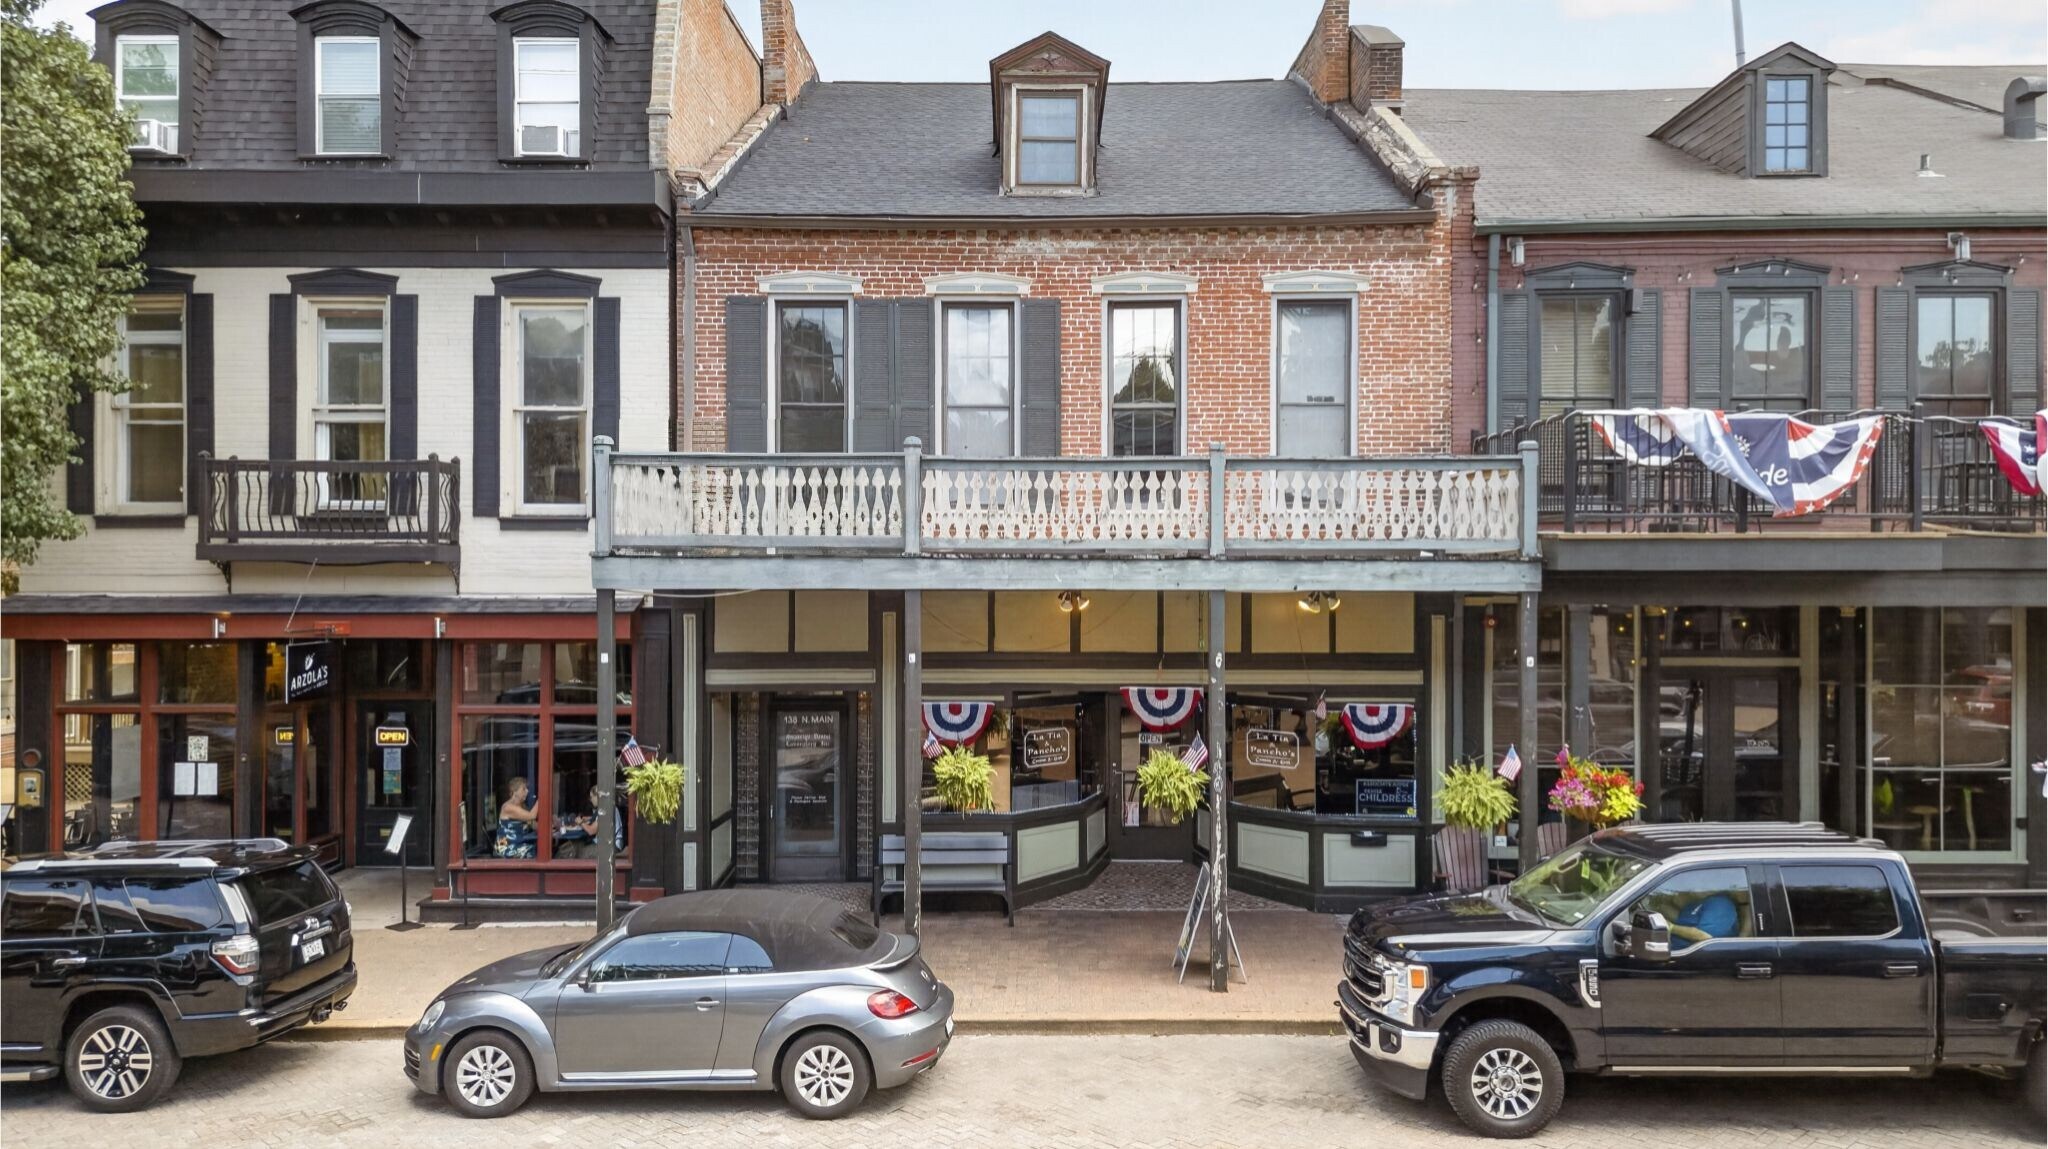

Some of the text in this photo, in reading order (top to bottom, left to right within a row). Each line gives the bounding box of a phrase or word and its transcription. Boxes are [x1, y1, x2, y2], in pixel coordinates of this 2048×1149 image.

[290, 664, 328, 691] ARZOLA'S
[811, 715, 834, 724] MAIN
[379, 732, 405, 742] OPEN
[1140, 734, 1162, 744] OPEN
[1027, 744, 1067, 756] Pancho's
[1250, 745, 1296, 757] Pancho's
[1359, 792, 1413, 803] CHILDRESS
